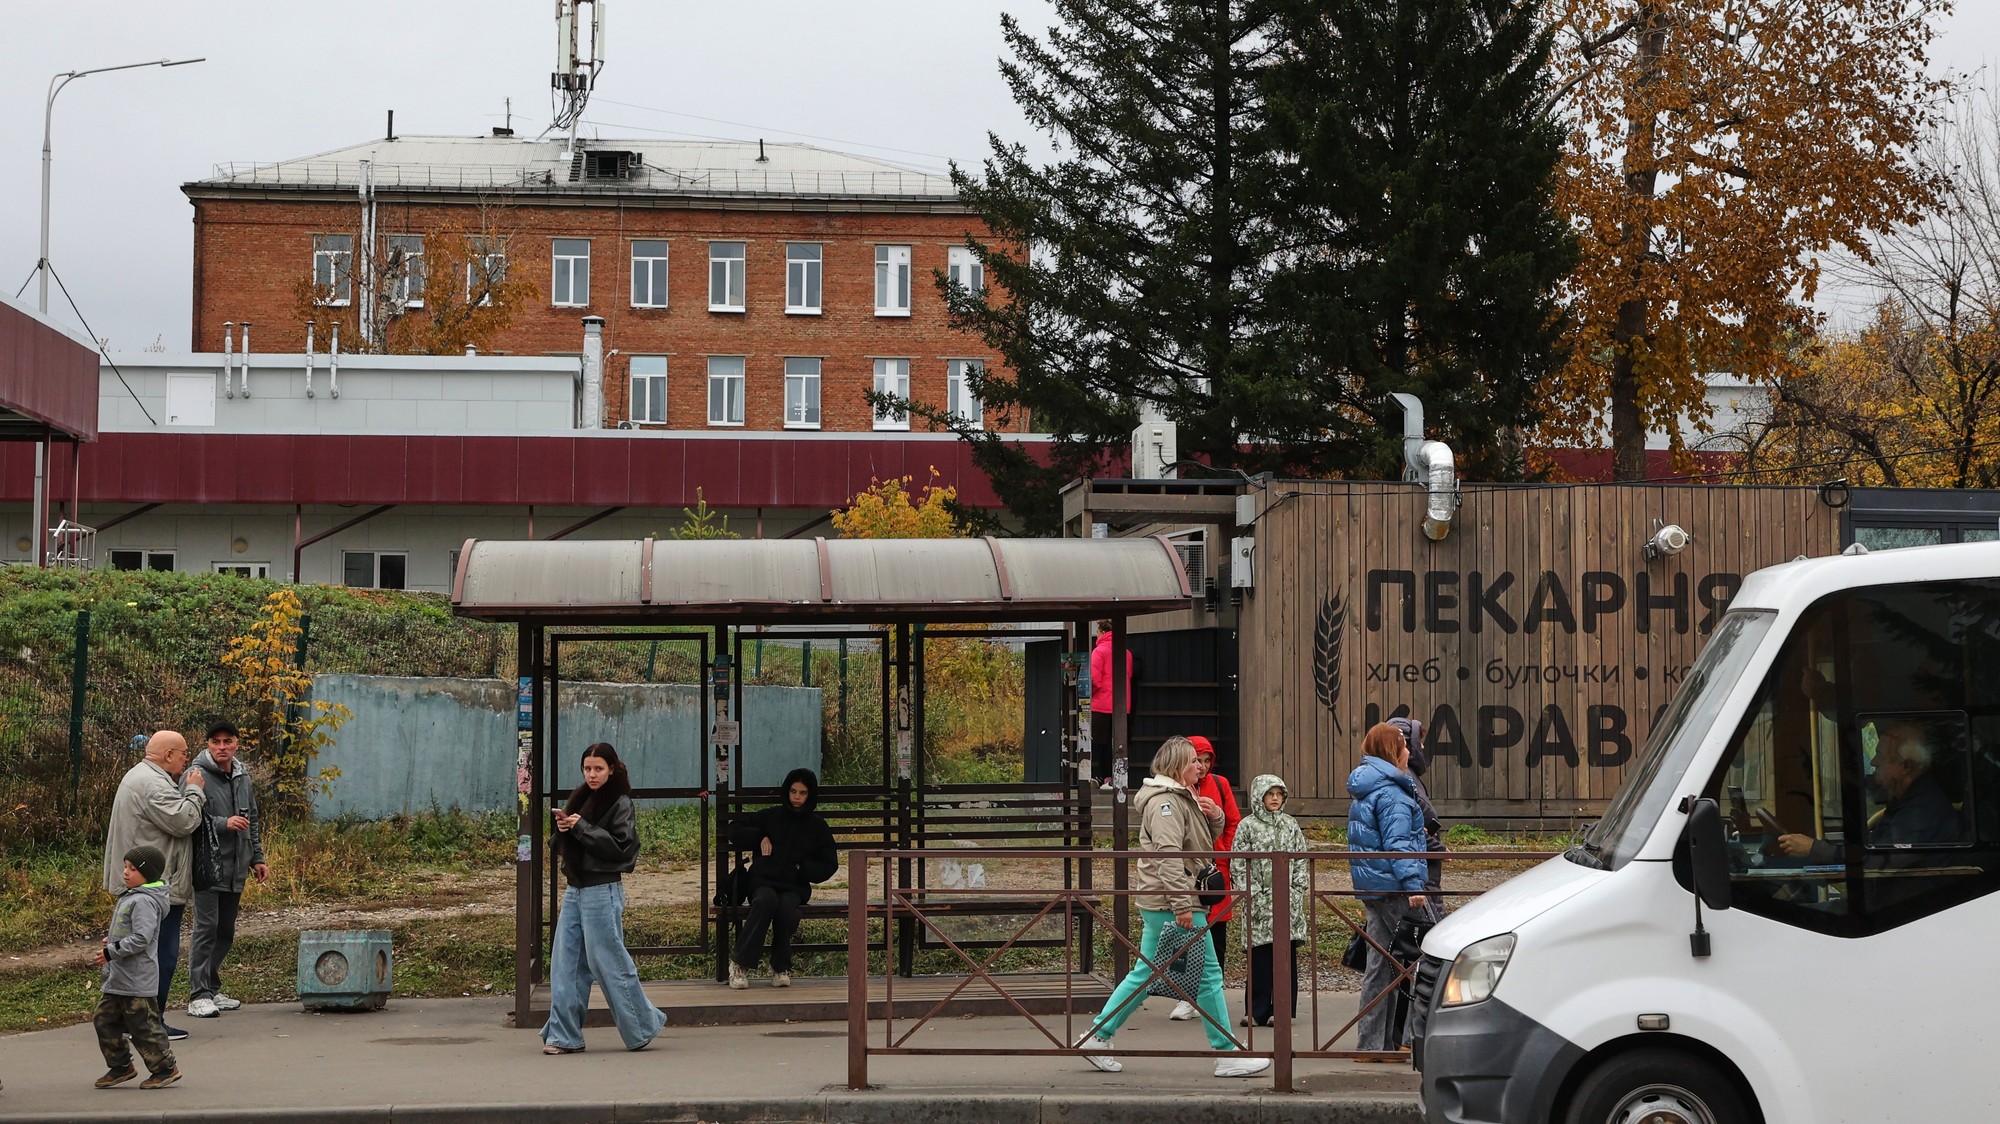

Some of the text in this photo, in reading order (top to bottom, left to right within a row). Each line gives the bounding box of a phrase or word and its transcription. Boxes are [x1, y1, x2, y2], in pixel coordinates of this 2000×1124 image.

[1368, 569, 1741, 634] ПЕКАРНЯ
[1367, 658, 1441, 683] хлеб
[1486, 658, 1619, 689] булочки
[1365, 703, 1669, 768] АРАВ
